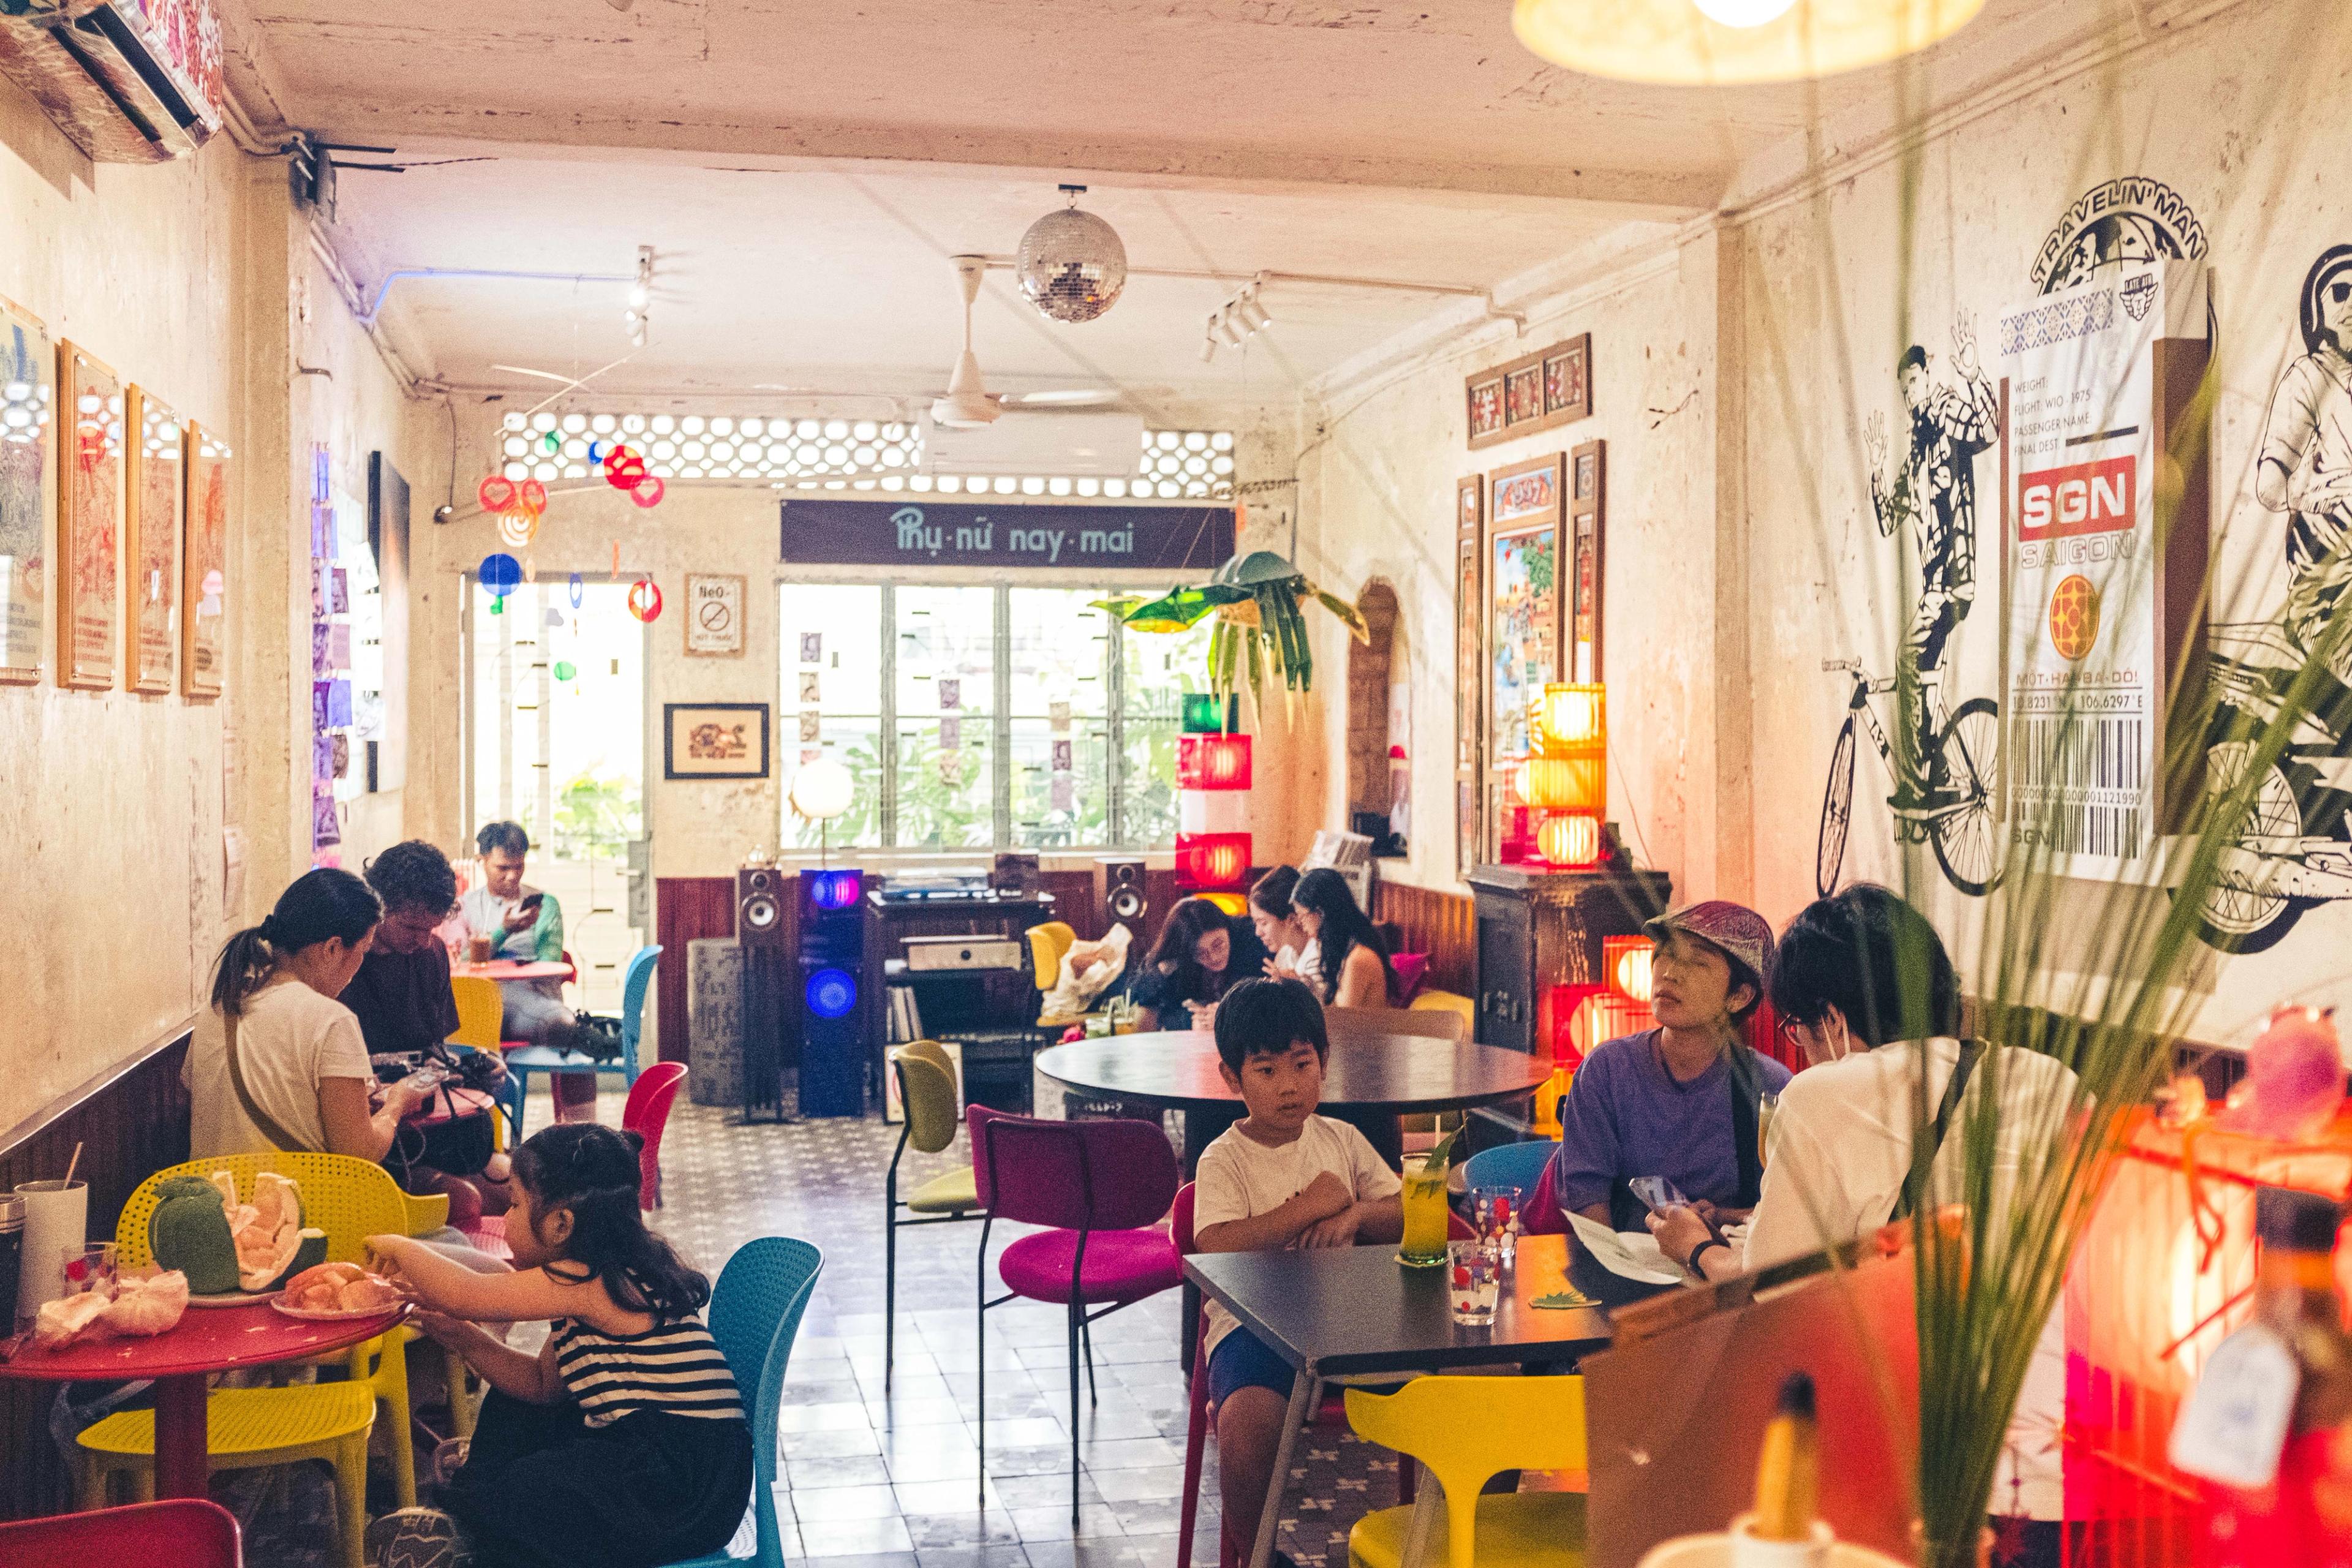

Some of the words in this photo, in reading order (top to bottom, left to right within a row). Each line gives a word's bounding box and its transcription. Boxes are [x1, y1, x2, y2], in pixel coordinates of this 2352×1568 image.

[2033, 181, 2153, 278] TRAVELIN'
[2154, 184, 2205, 262] MAN
[2014, 376, 2048, 394] WEIGHT:
[2014, 398, 2043, 417] FLIGHT:
[2071, 388, 2092, 404] 1975
[2014, 418, 2062, 439] PASSENGER
[2014, 443, 2037, 457] FINAL
[2024, 472, 2125, 529] SGN
[2021, 531, 2134, 569] SAIGON
